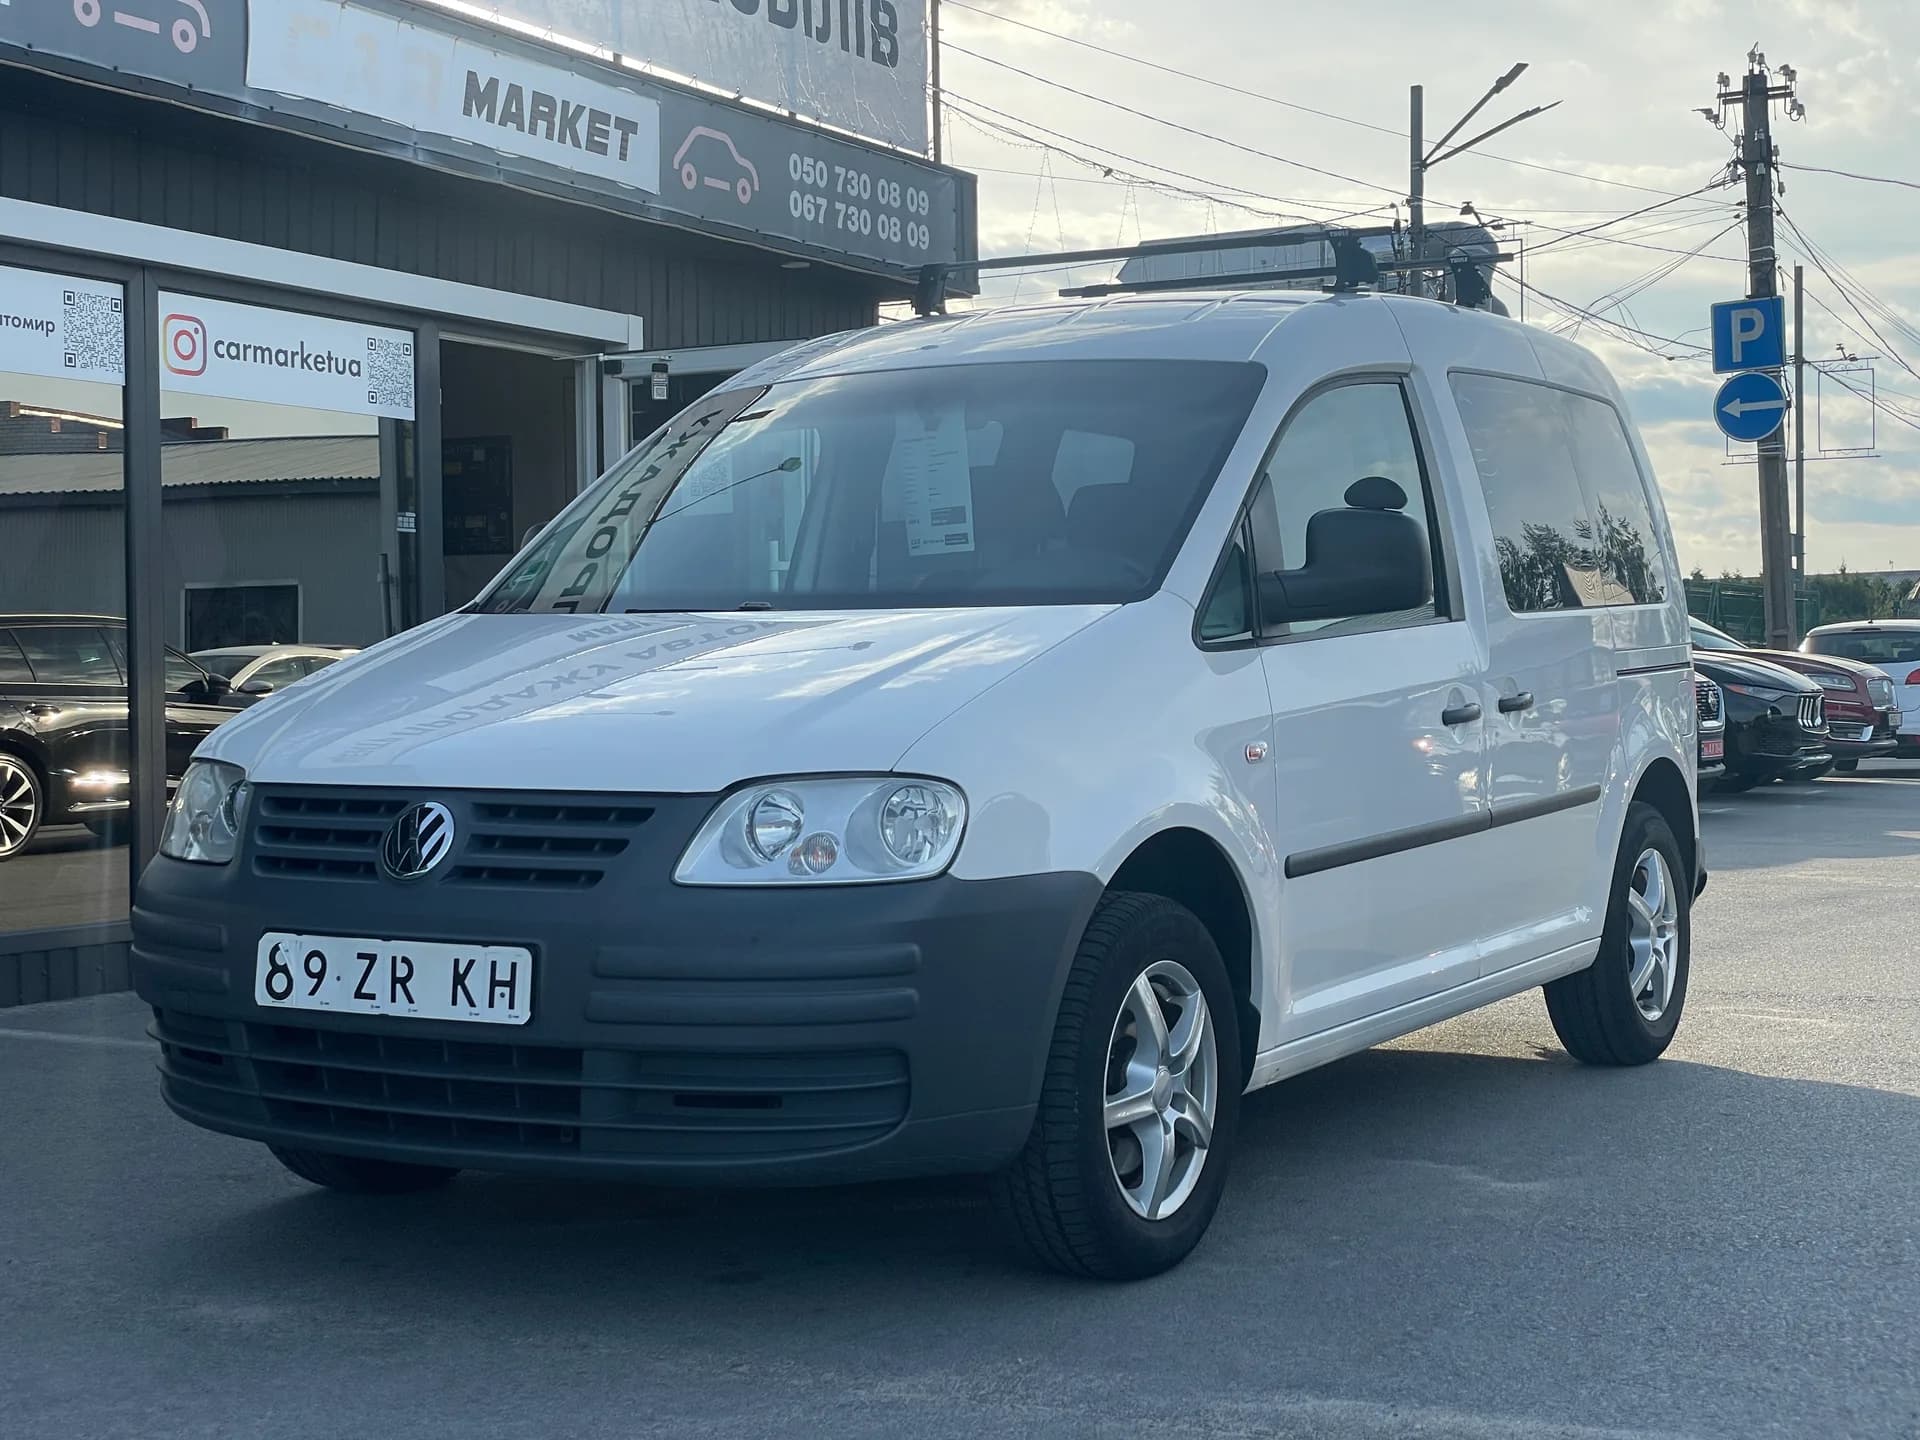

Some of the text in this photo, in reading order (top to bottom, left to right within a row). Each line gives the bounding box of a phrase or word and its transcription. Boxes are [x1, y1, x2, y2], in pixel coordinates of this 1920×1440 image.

[463, 70, 639, 162] MARKET
[789, 153, 929, 215] 050 730 08 09
[789, 190, 930, 250] 067 730 08 09
[0, 313, 56, 338] томир
[1730, 308, 1765, 363] P
[213, 340, 361, 377] carmarketua
[353, 952, 415, 1005] ZR
[451, 957, 517, 1010] KH
